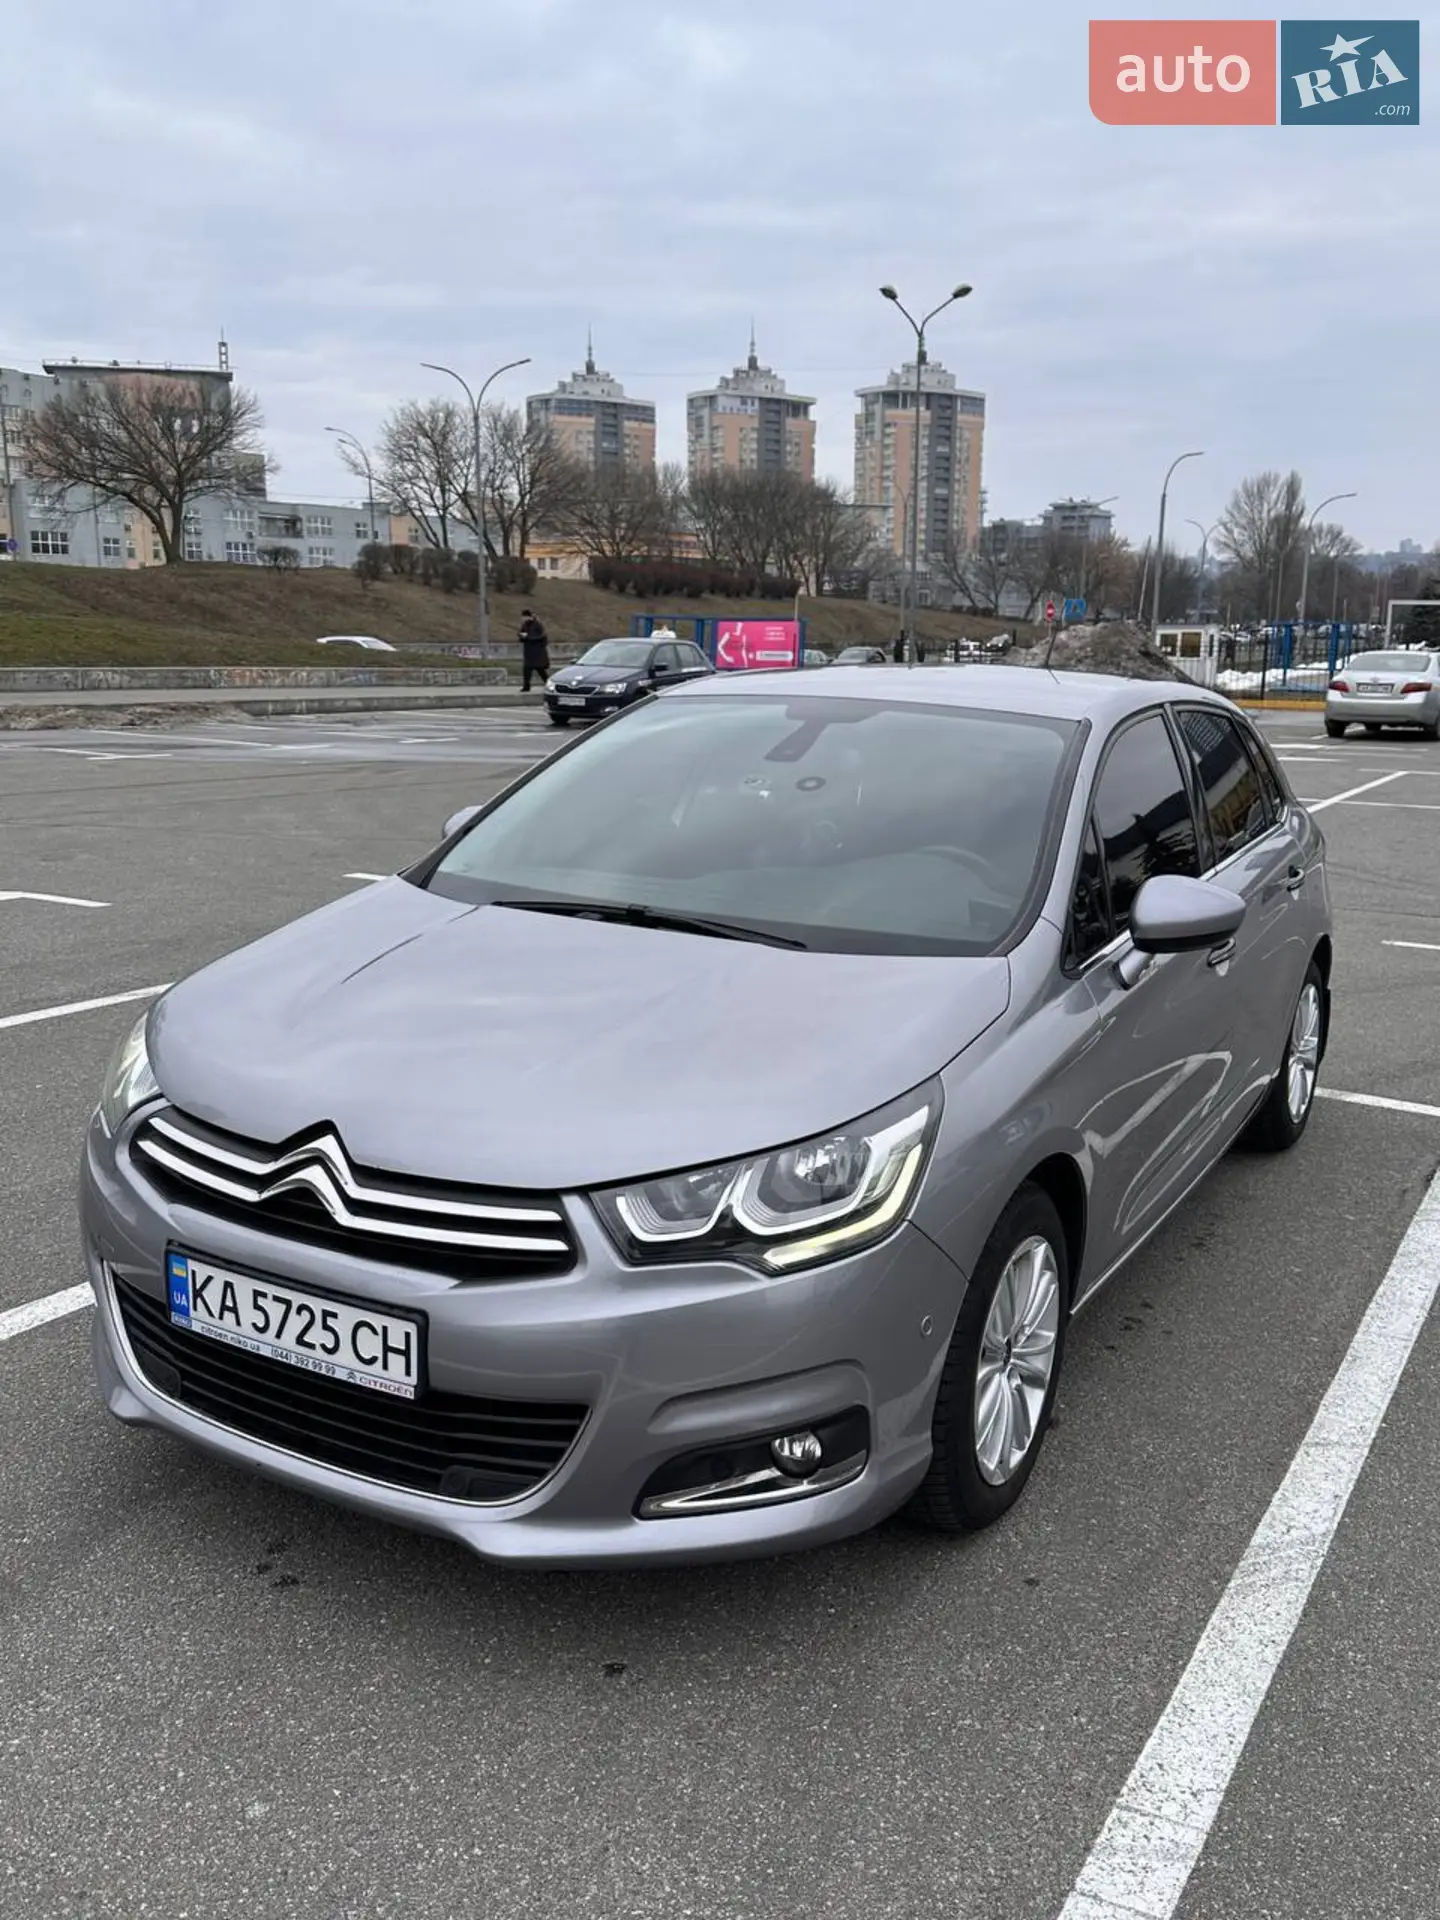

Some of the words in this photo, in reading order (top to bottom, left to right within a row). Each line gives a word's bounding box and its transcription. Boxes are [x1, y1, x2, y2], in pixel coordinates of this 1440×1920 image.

[173, 1292, 188, 1308] UA
[191, 1269, 241, 1327] KA
[251, 1289, 341, 1355] 5725
[351, 1320, 412, 1378] CH
